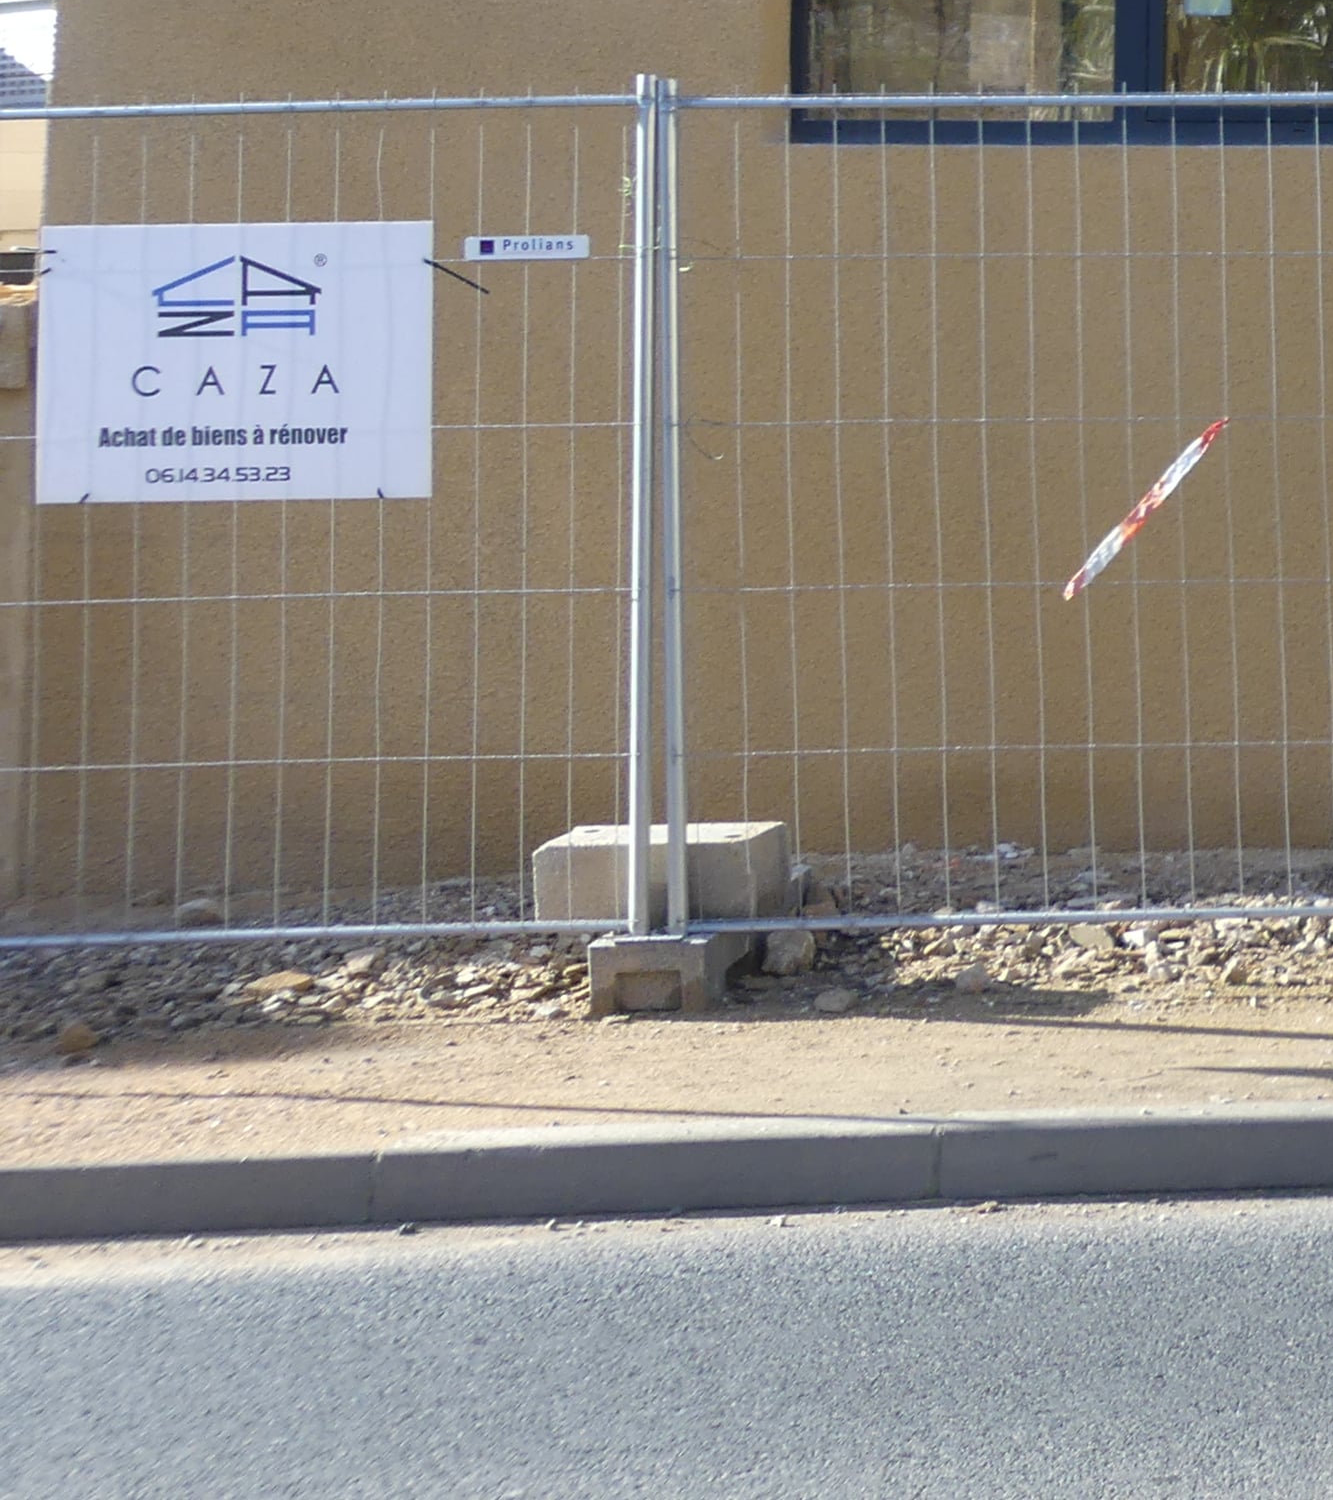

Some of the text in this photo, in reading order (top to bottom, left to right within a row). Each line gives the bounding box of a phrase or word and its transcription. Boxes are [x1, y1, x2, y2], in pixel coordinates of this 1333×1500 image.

[502, 237, 575, 251] Prolians
[131, 364, 340, 397] CAZA
[98, 423, 349, 448] Achat de biens à rénover
[145, 465, 291, 484] 06.14.34.53.23
